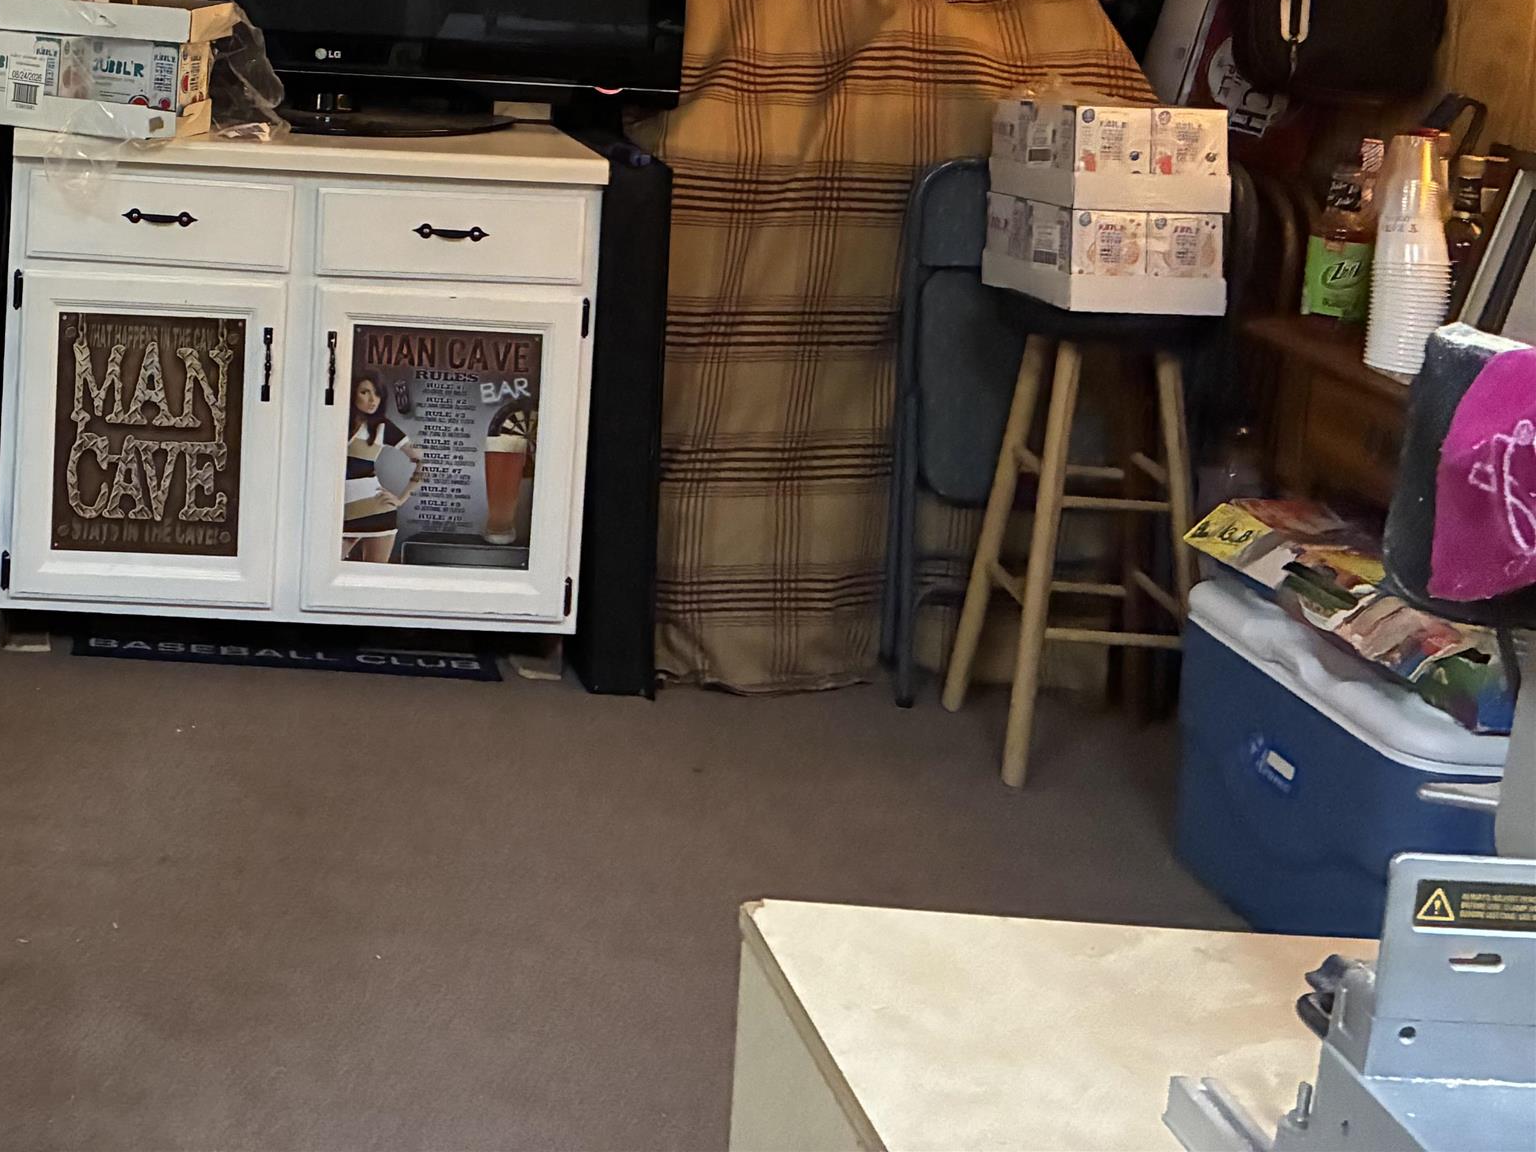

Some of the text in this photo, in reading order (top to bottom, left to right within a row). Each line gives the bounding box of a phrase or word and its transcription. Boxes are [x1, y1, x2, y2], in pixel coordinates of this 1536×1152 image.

[328, 50, 342, 59] LG
[367, 334, 531, 373] MAN CAVE
[70, 341, 234, 435] MAN
[415, 369, 479, 383] RULES
[480, 377, 531, 405] BAR
[66, 432, 228, 523] CAVE
[88, 637, 482, 671] BASEBALL CLUB
